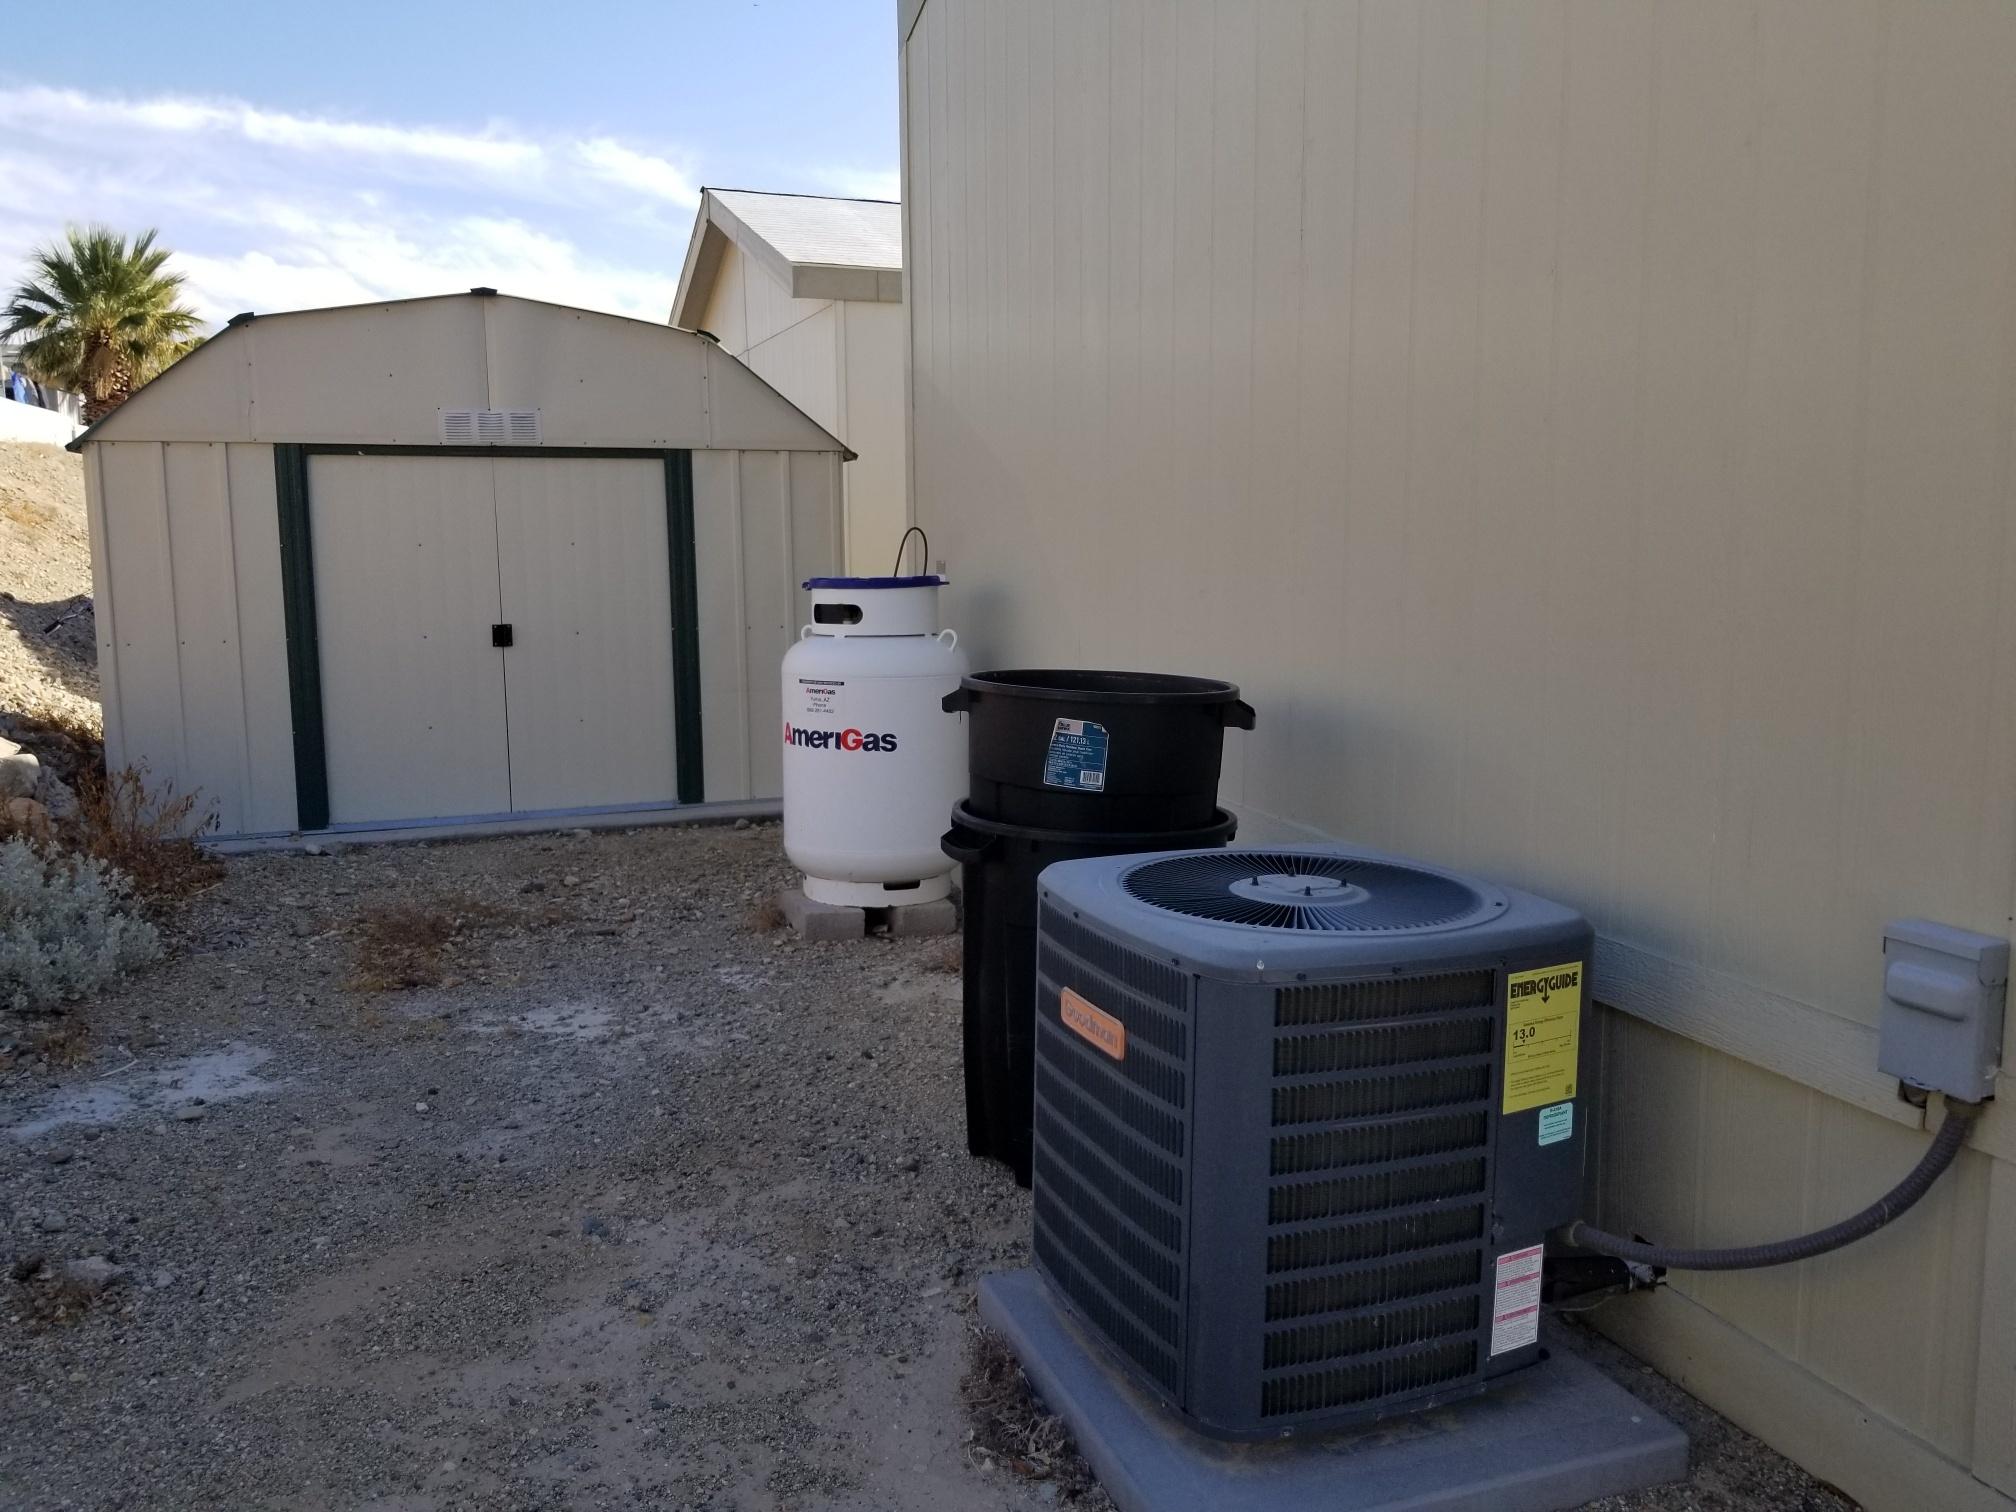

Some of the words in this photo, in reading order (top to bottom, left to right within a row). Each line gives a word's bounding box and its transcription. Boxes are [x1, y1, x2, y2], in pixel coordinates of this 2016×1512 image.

[785, 722, 897, 752] AmeriGas
[1064, 1001, 1118, 1049] Goodman
[1513, 1027, 1536, 1040] 13.0
